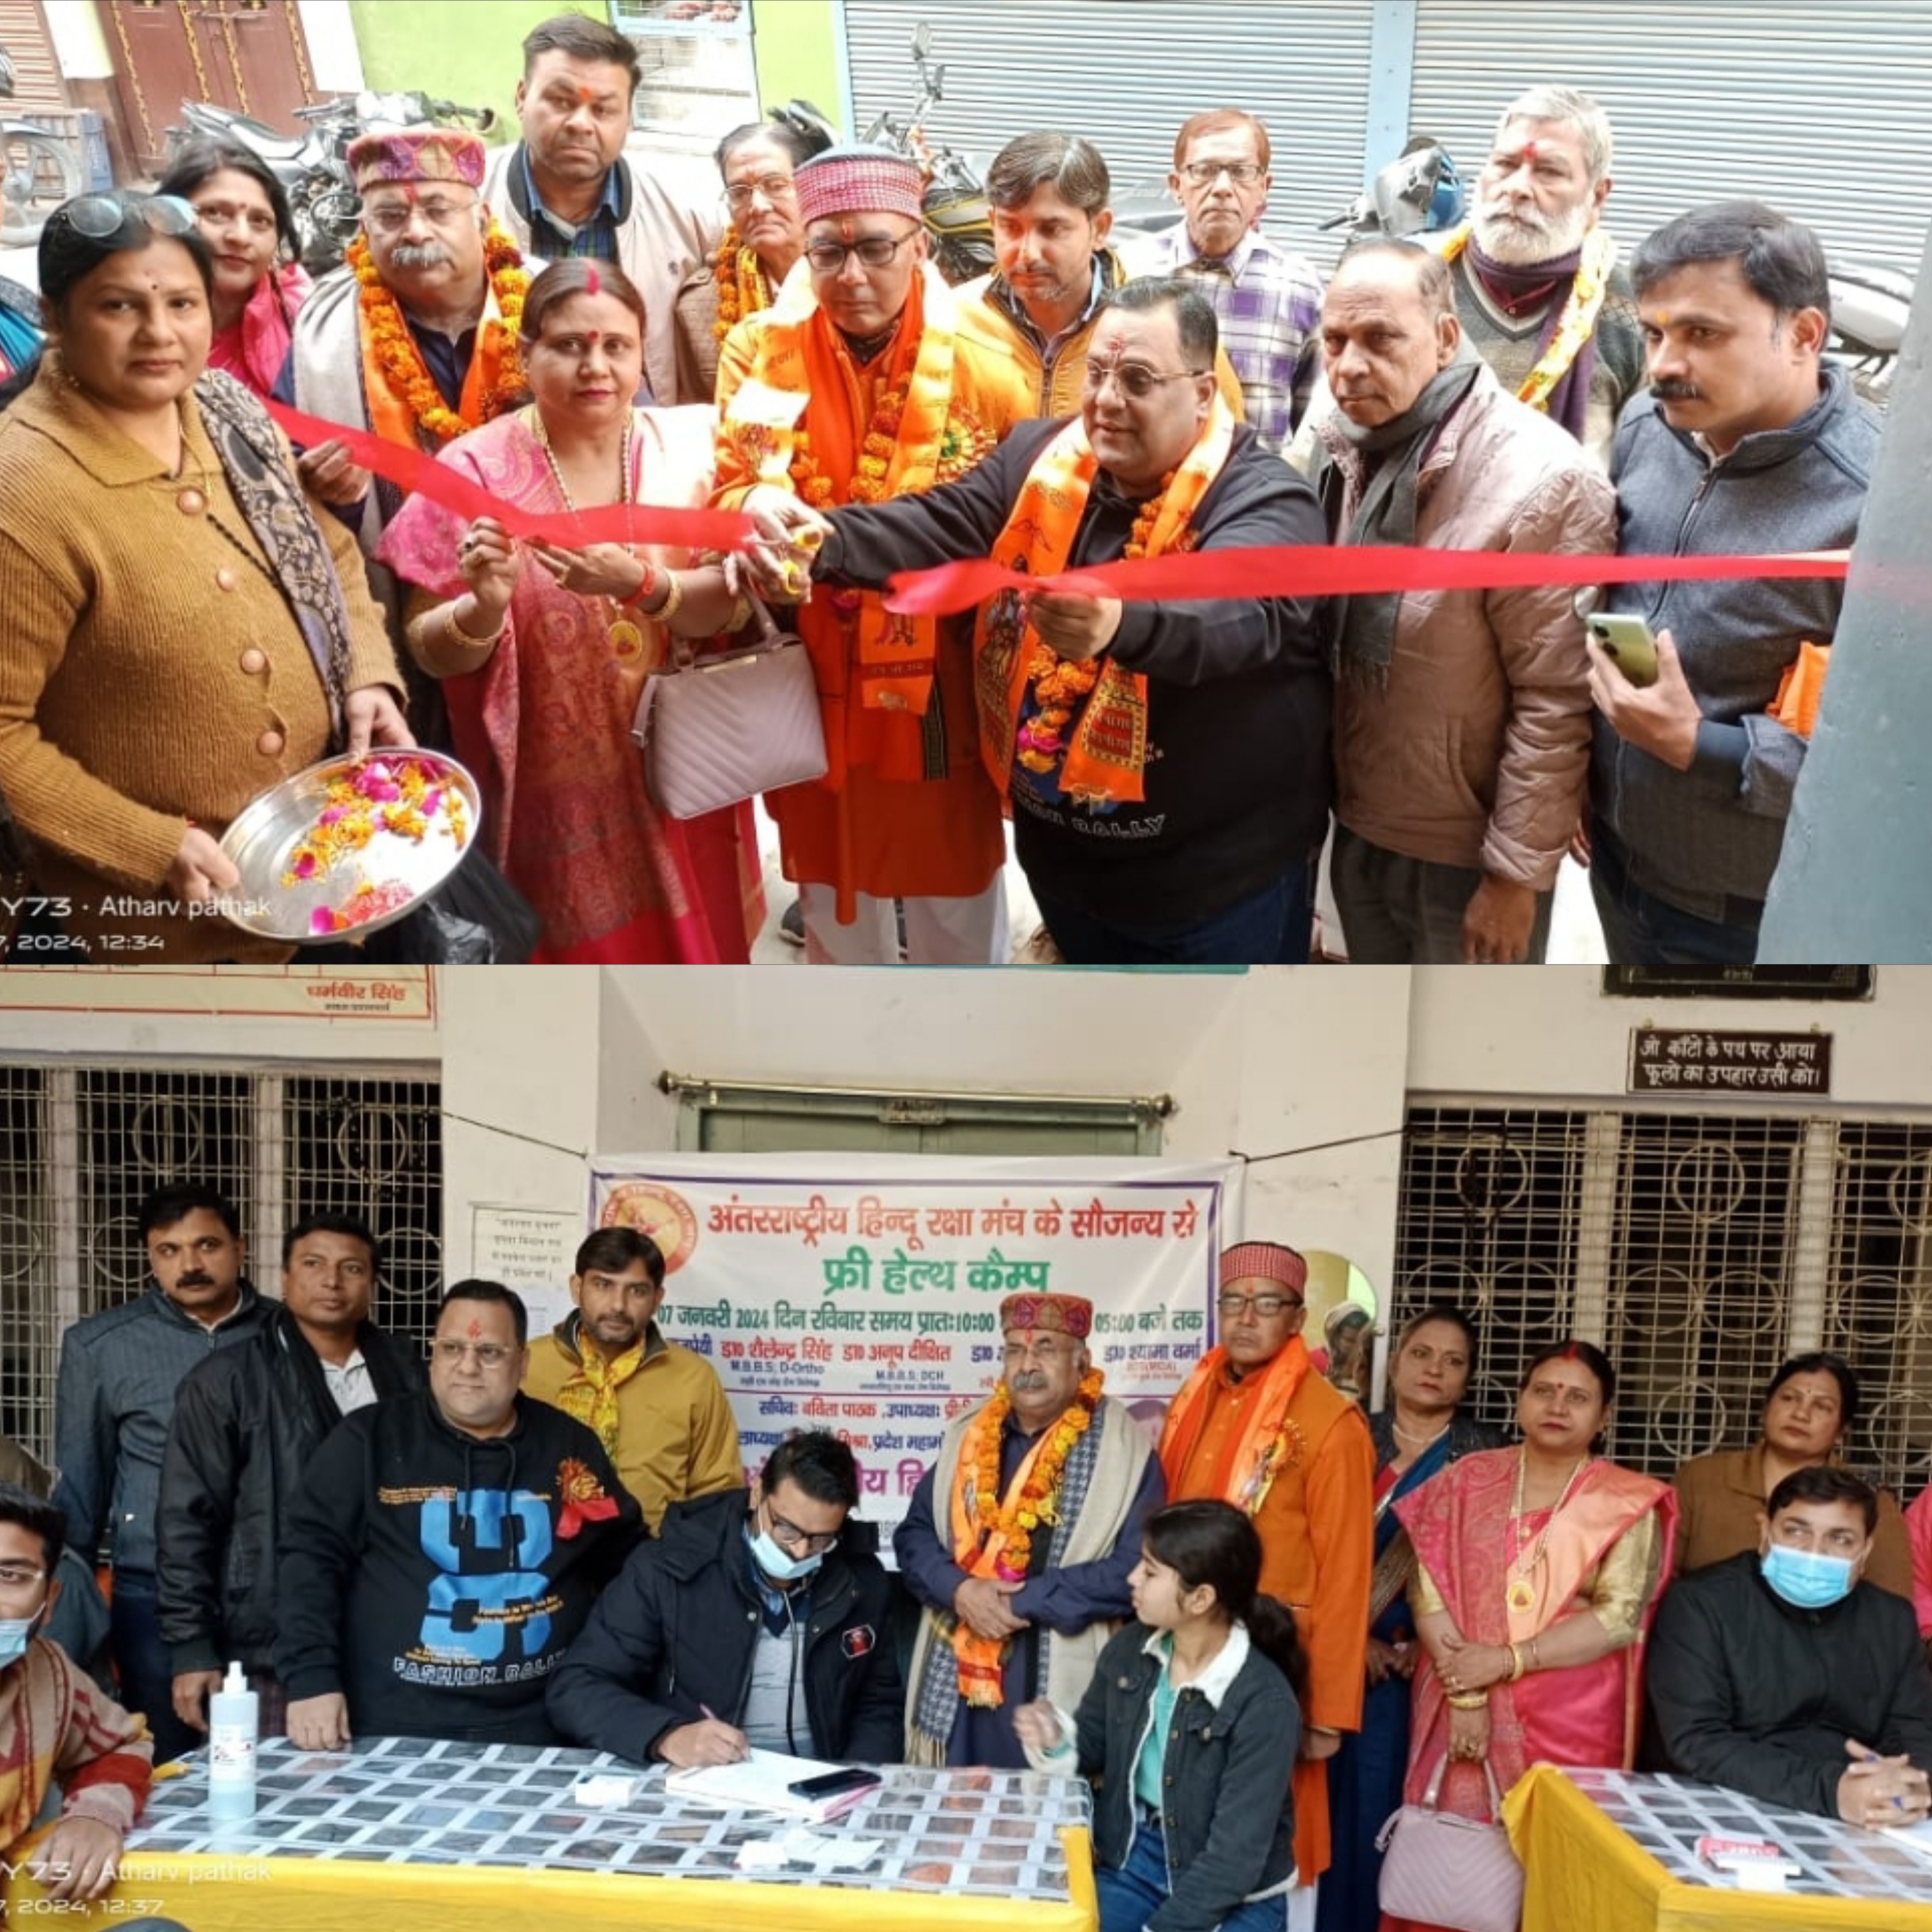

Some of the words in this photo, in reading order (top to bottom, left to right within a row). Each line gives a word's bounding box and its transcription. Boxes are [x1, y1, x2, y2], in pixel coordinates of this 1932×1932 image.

[1749, 1041, 1772, 1060] पर
[1774, 1041, 1816, 1060] आया
[1683, 1065, 1704, 1083] का
[1706, 1066, 1757, 1087] उपहार
[858, 1195, 924, 1250] हिन्दू
[926, 1208, 974, 1236] रक्षा
[981, 1199, 1027, 1237] मंच
[1033, 1198, 1063, 1237] के
[1070, 1197, 1166, 1238] सौजन्य
[1173, 1199, 1199, 1238] से
[823, 1246, 873, 1295] फ्री
[881, 1248, 958, 1294] हेल्थ
[967, 1246, 1051, 1291] कैम्प
[677, 1299, 731, 1328] जनवरी
[736, 1309, 768, 1328] 2024
[774, 1300, 806, 1329] दिन
[810, 1301, 866, 1331] रविवार
[868, 1310, 913, 1331] समय
[1095, 1313, 1134, 1332] 05:00
[1138, 1302, 1166, 1332] बजे
[1172, 1311, 1204, 1331] तक
[802, 1337, 833, 1361] सिंह
[779, 1362, 825, 1374] D-Ortho
